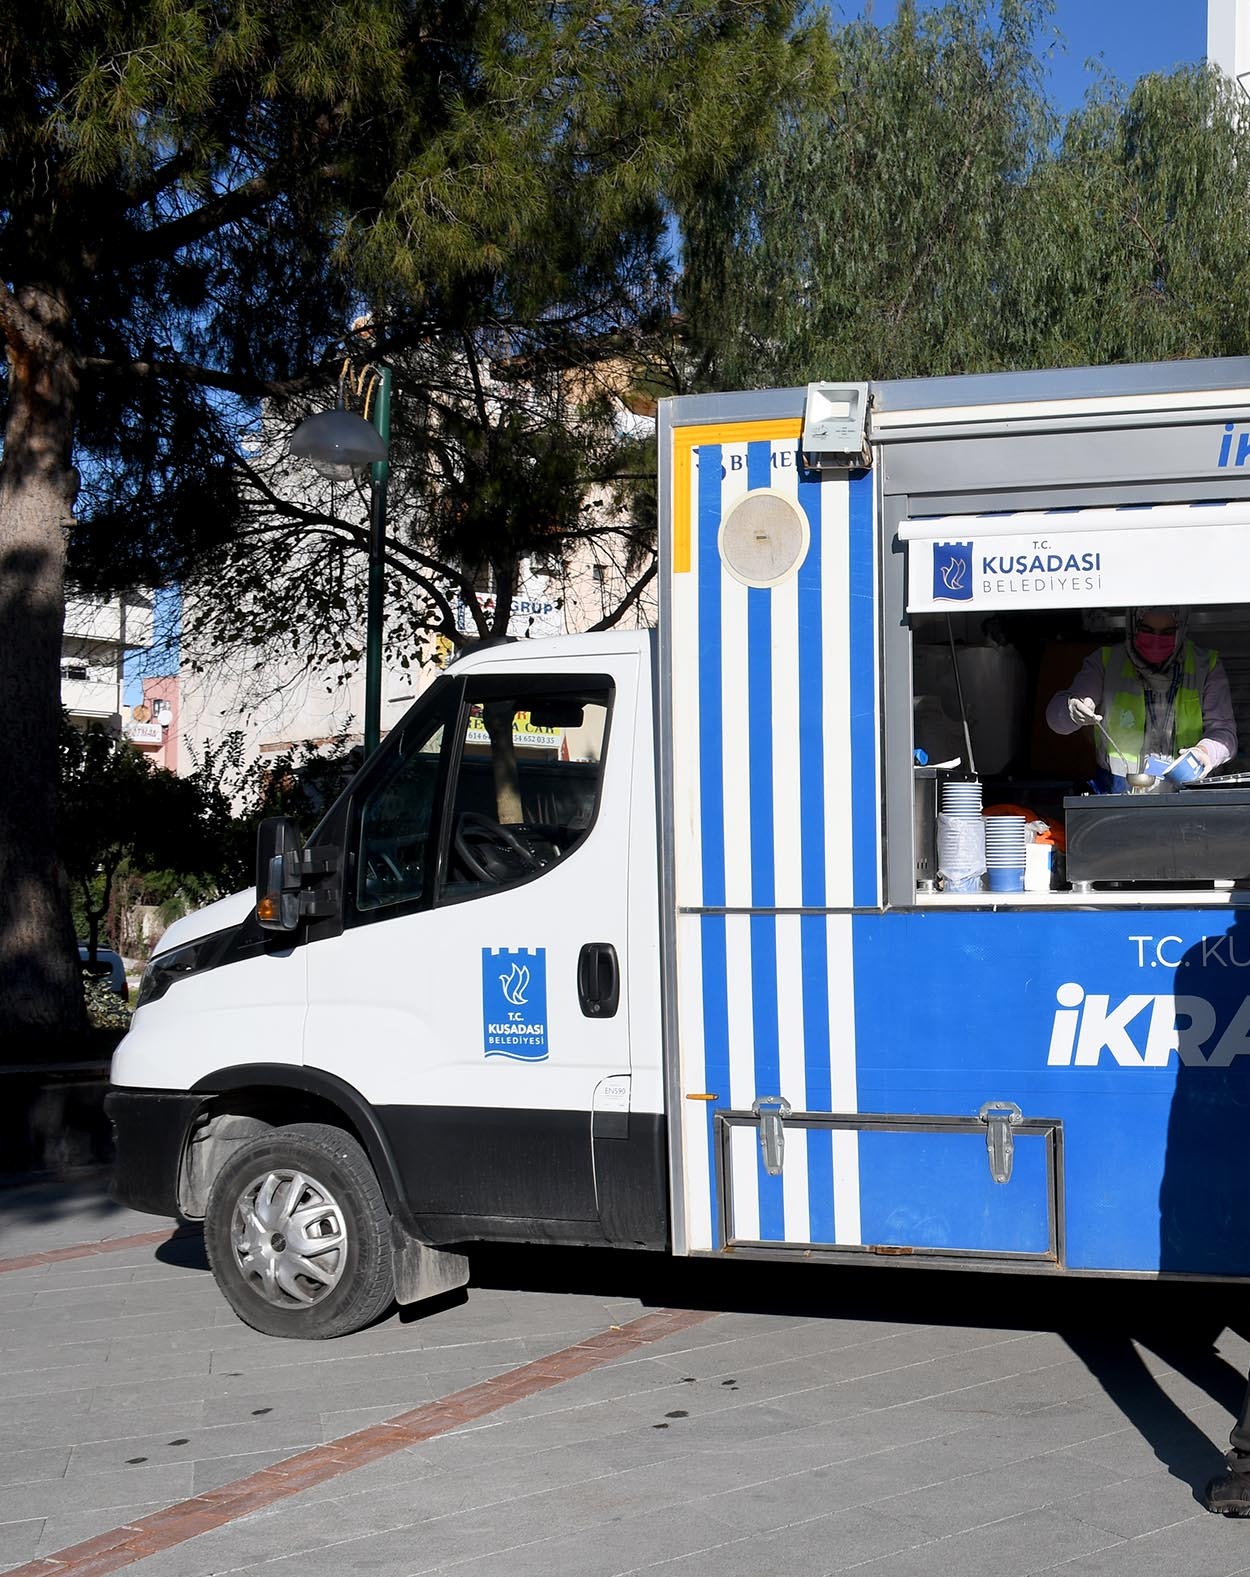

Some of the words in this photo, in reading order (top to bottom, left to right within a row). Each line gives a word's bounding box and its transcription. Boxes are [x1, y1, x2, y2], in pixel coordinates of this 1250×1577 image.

[1032, 540, 1052, 550] T.C.
[982, 553, 1100, 575] KUŞADASI
[983, 574, 1101, 593] BELEDİYESİ
[1128, 935, 1190, 968] T.C.
[508, 1012, 524, 1021] T.C.
[488, 1023, 544, 1035] KUŞADASI
[488, 1035, 544, 1045] BELEDİYESİ
